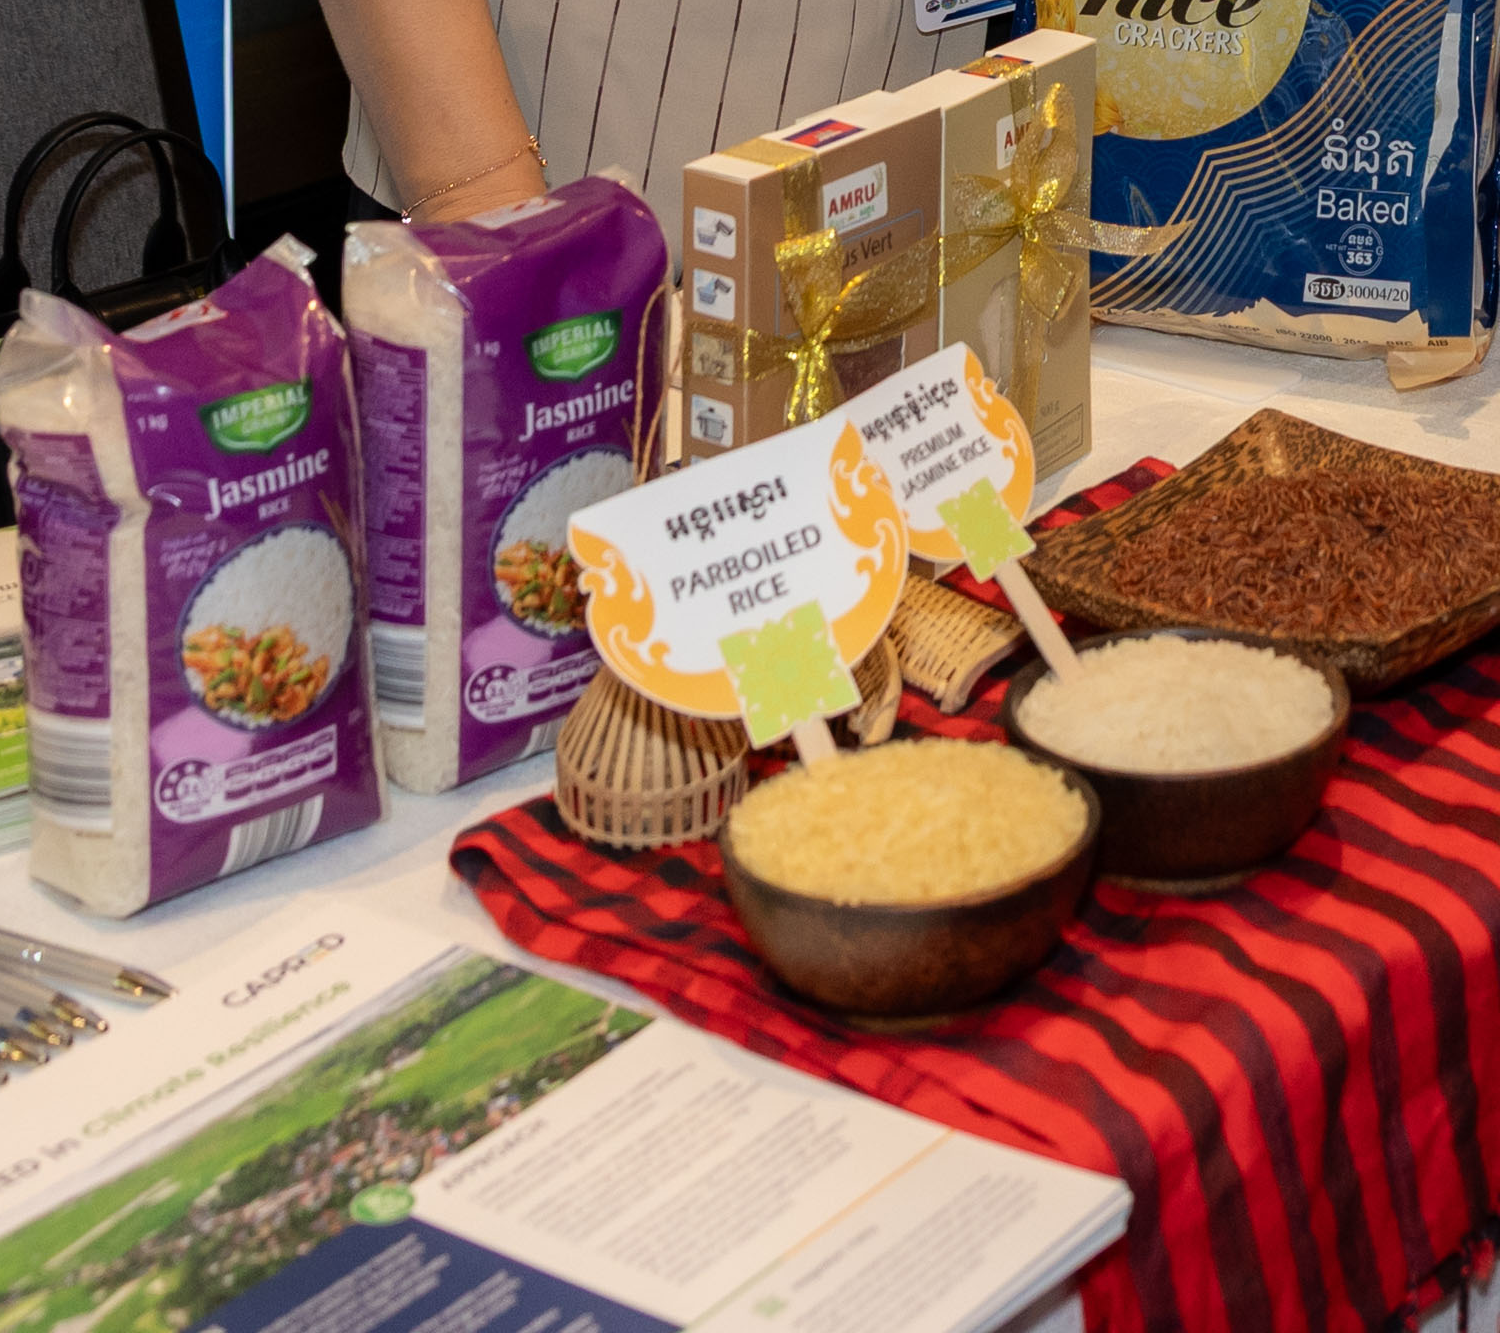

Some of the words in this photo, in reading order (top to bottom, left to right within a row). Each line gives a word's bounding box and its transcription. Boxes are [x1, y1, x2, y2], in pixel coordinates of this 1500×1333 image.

[1114, 21, 1246, 55] CRACKERS
[828, 182, 875, 218] AMRU
[1316, 188, 1410, 226] Baked
[861, 231, 892, 260] Vert
[1346, 251, 1373, 266] 363
[1346, 284, 1409, 302] 30004/20
[532, 318, 616, 358] IMPERIAL
[1300, 333, 1333, 343] 22000
[211, 384, 309, 430] IMPERIAL
[518, 379, 634, 442] Jasmine
[566, 421, 596, 443] RICE
[899, 422, 966, 470] PREMIUM
[204, 448, 329, 521] Jasmine
[901, 453, 963, 501] JASMINE
[959, 434, 992, 463] RICE
[670, 524, 821, 602] PARBOILED
[728, 572, 790, 616] RICE
[41, 1135, 82, 1162] in
[82, 1065, 205, 1137] Climate
[206, 979, 352, 1069] Resilience
